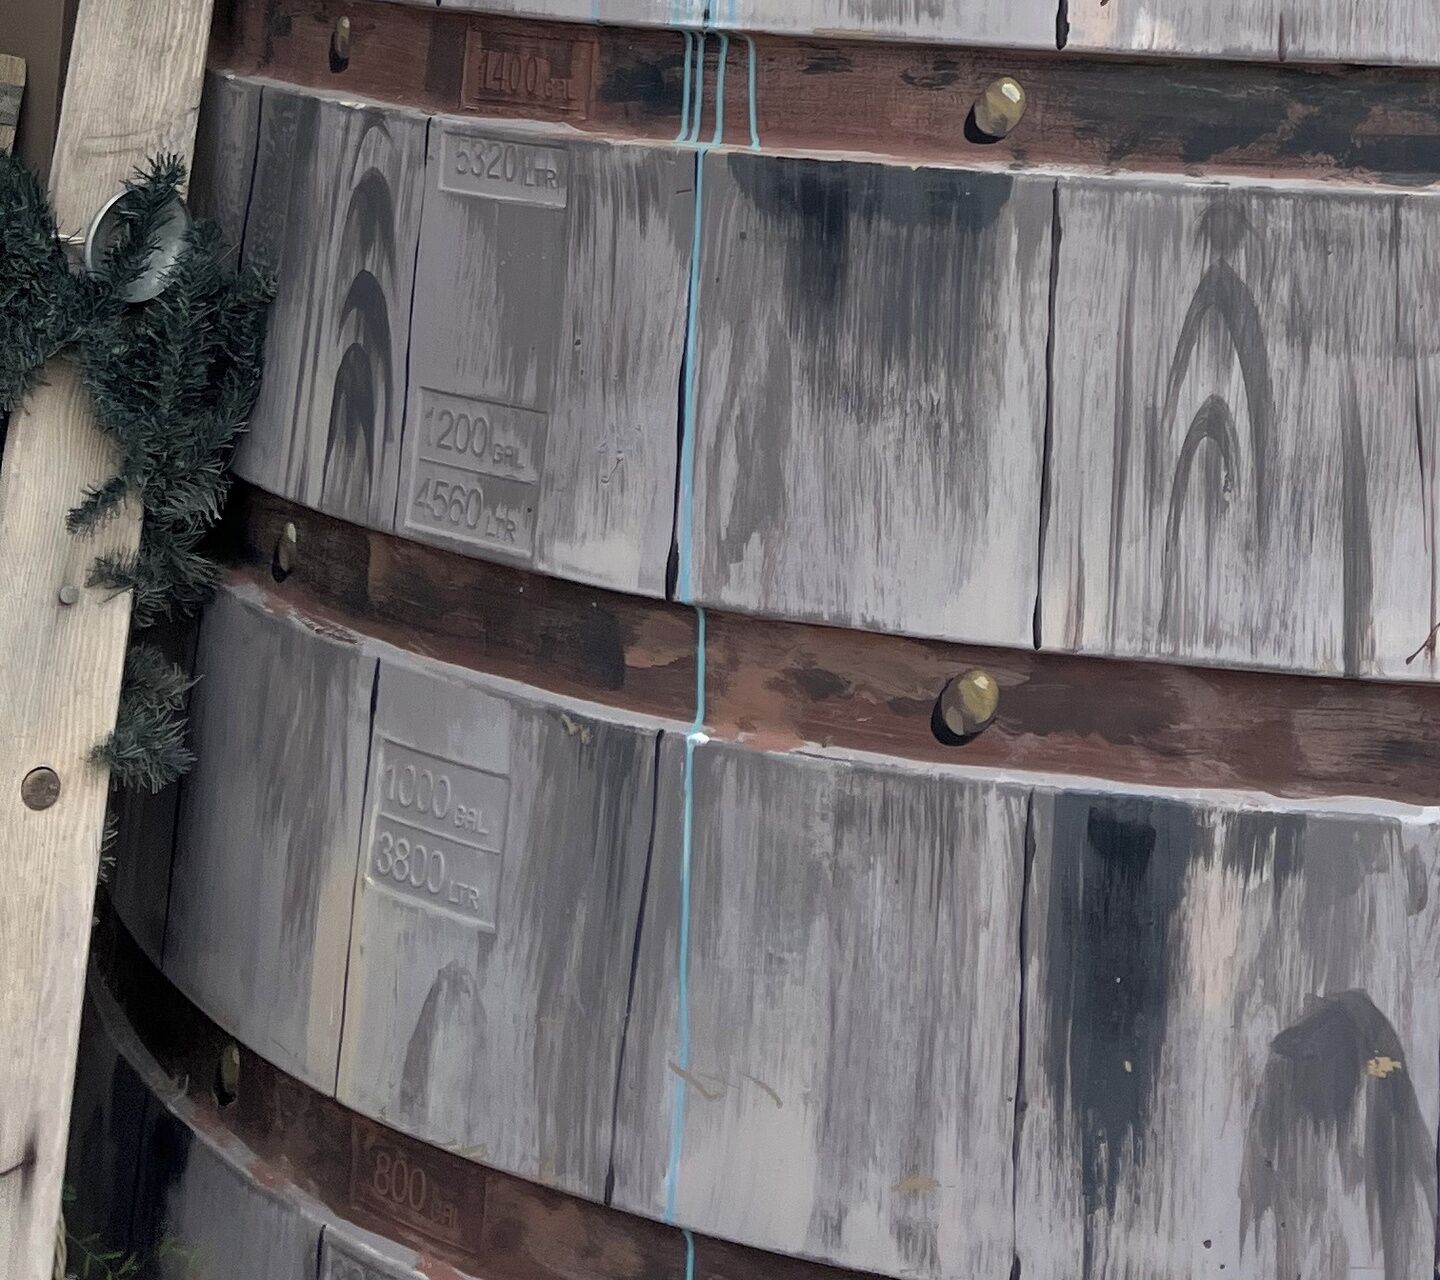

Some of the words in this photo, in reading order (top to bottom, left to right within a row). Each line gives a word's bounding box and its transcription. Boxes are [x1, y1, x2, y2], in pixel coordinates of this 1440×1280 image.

[479, 52, 538, 94] 1400
[456, 140, 518, 182] 5320
[524, 160, 559, 189] LTR
[424, 406, 490, 459] 1200
[493, 442, 526, 470] GAL
[414, 477, 484, 530] 4560
[484, 510, 517, 544] LTR
[385, 764, 451, 820] 1000
[454, 803, 490, 835] GAL
[376, 830, 446, 895] 3800
[448, 879, 481, 910] LTR
[373, 1151, 427, 1211] 800
